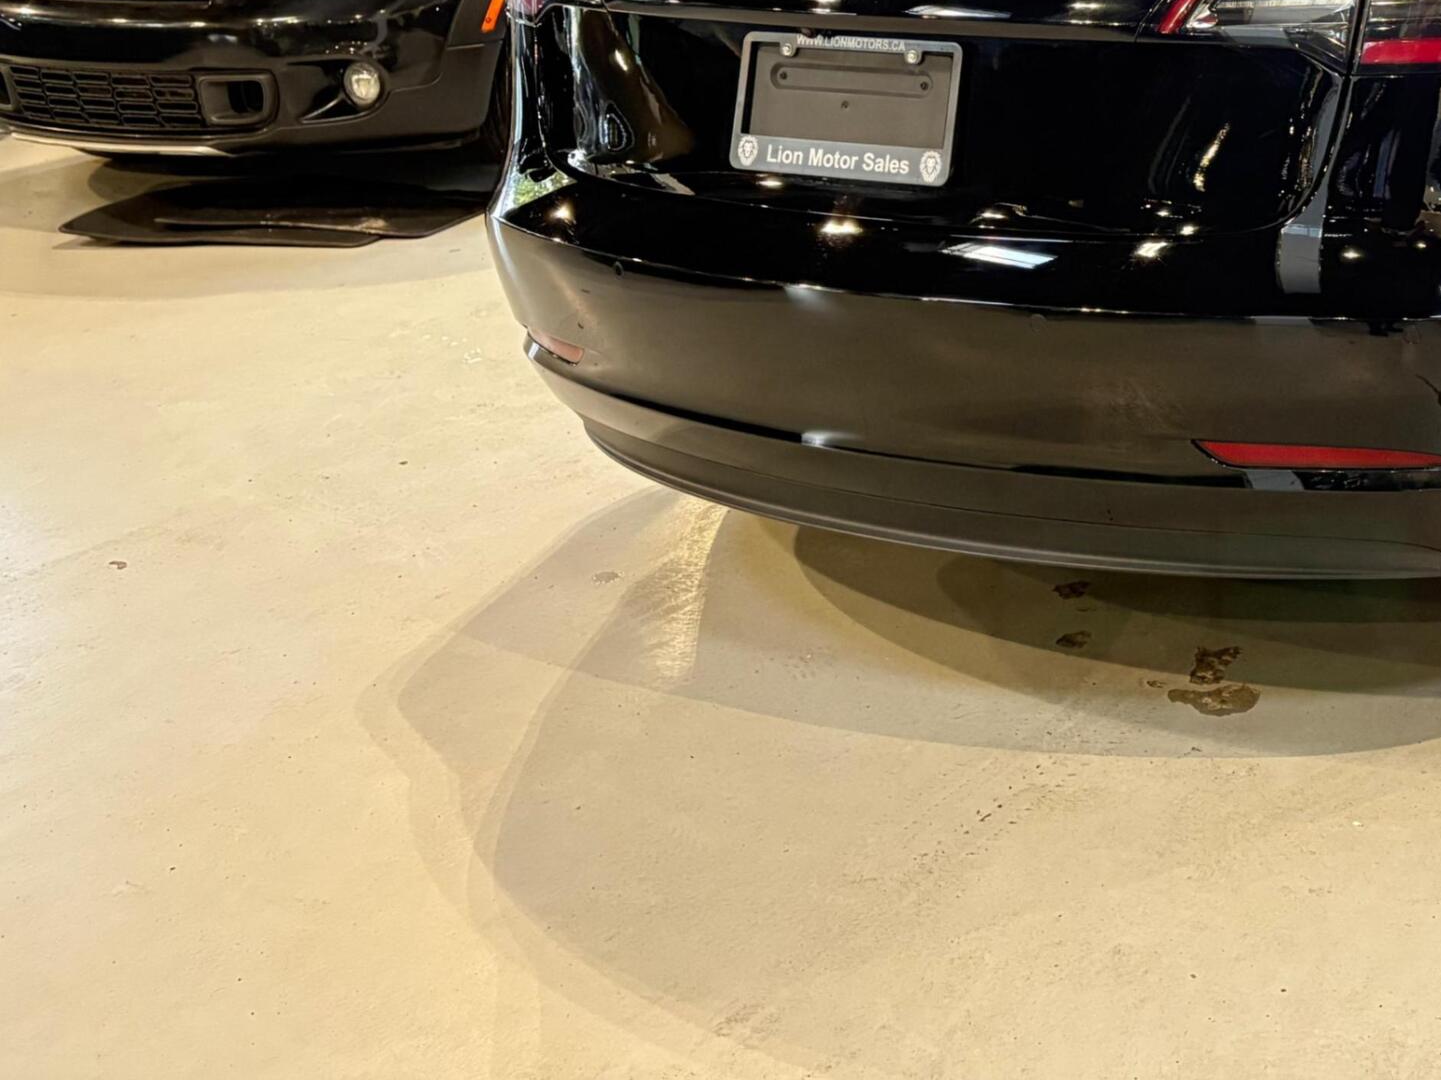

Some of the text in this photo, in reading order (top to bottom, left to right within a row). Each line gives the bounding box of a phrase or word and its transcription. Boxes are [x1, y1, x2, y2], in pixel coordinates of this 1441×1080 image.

[766, 144, 910, 174] Lion Motor Sales
